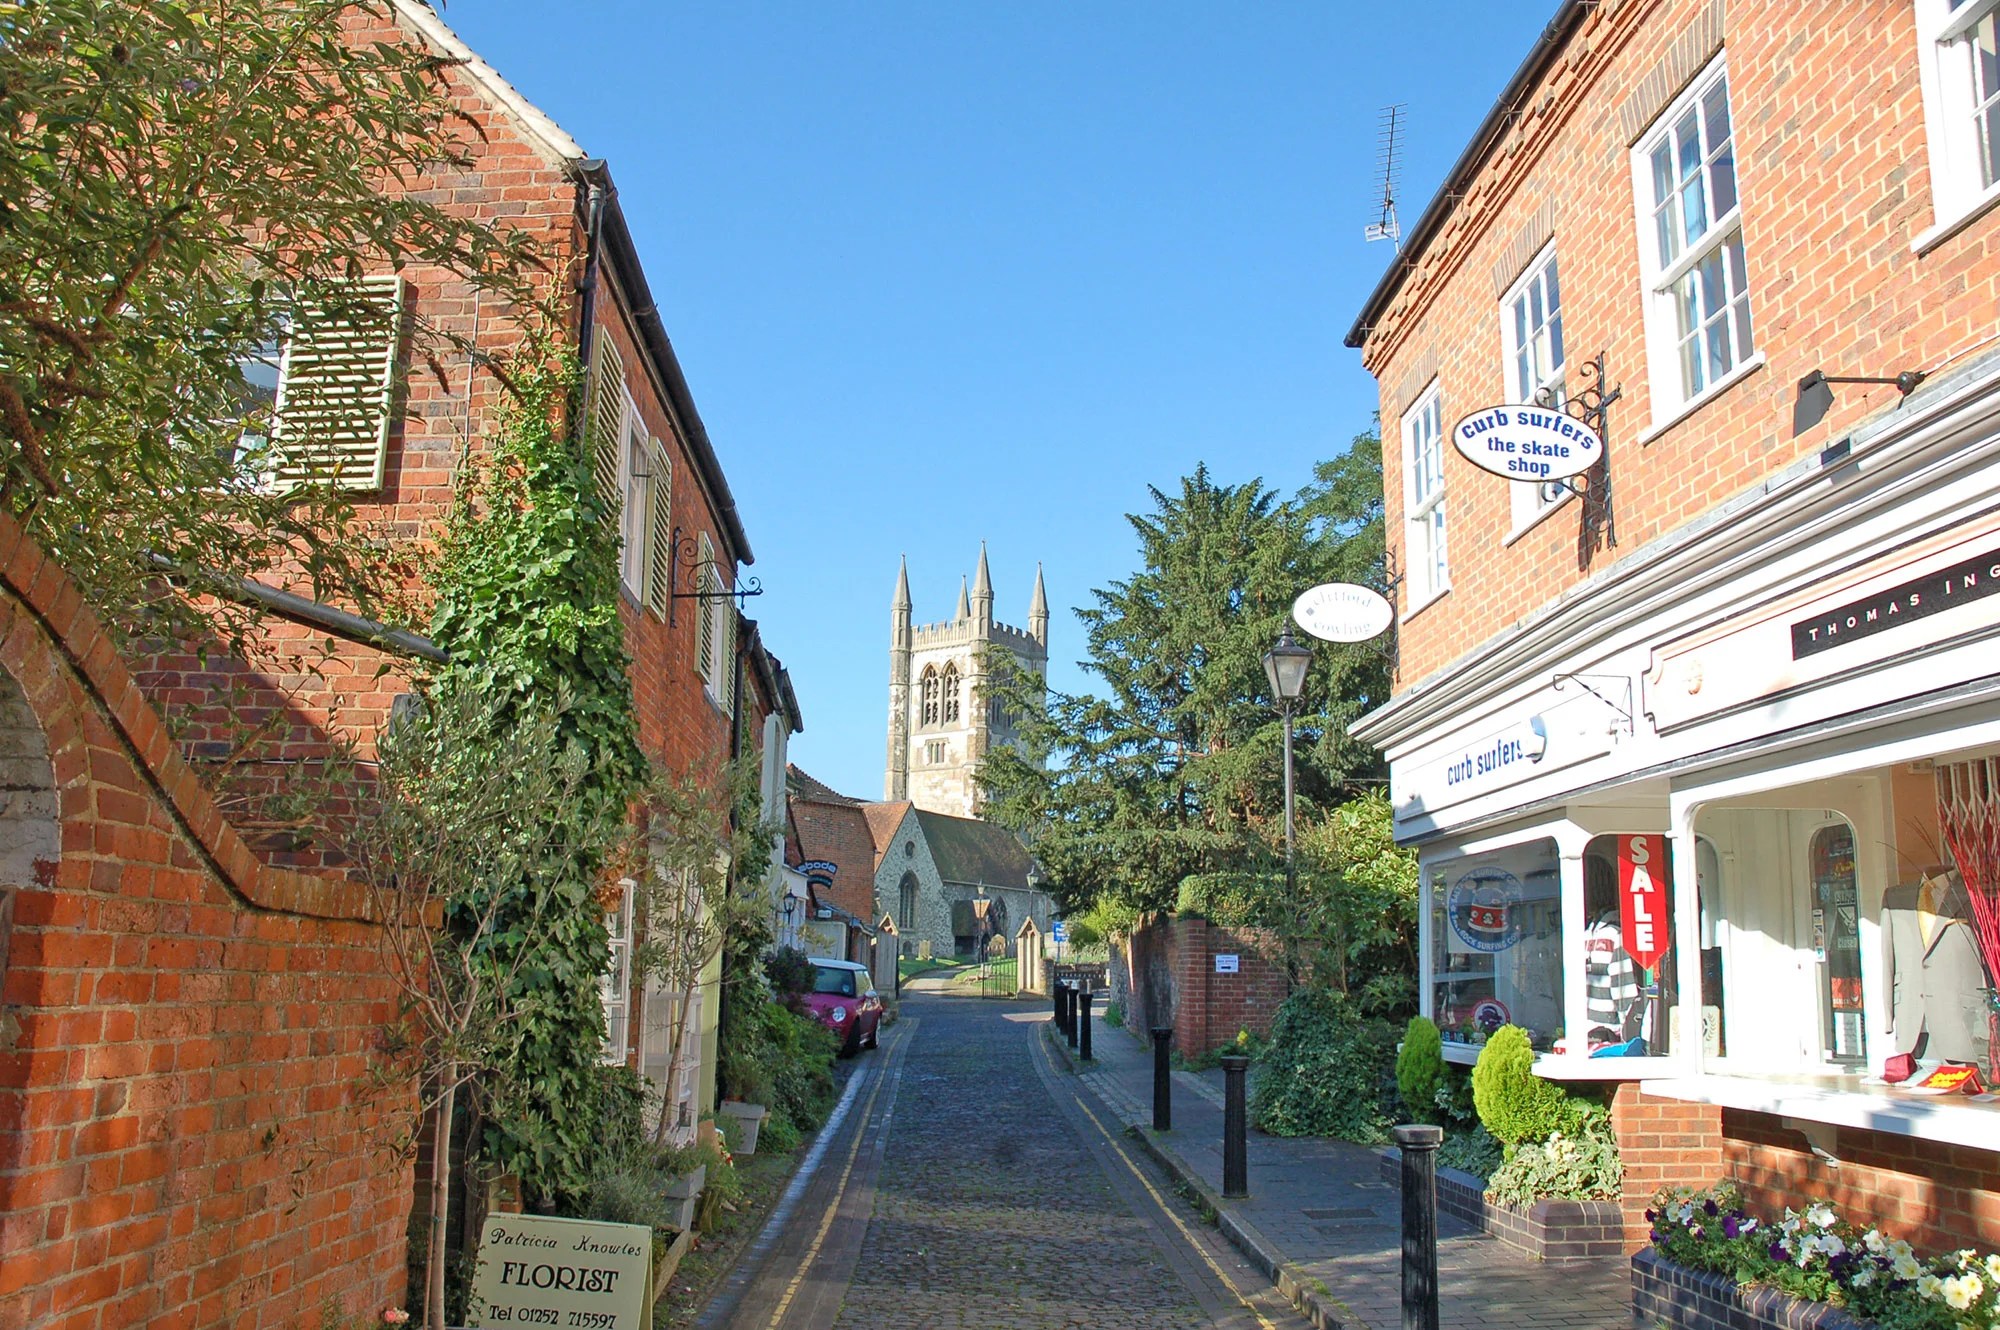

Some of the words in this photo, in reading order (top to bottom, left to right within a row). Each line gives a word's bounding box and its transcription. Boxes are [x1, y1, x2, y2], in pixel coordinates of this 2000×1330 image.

[1461, 409, 1509, 439] curb
[1517, 411, 1594, 450] surfers
[1487, 437, 1515, 453] the
[1522, 440, 1569, 458] skate
[1508, 457, 1550, 477] shop
[1809, 593, 1920, 641] THOMAS
[1447, 754, 1473, 786] curb
[1477, 739, 1524, 776] surfers
[1629, 836, 1655, 952] SALE
[491, 1227, 558, 1249] Patricia
[572, 1235, 642, 1257] Knowles
[500, 1261, 619, 1293] FLORIST
[489, 1305, 512, 1321] Tel
[518, 1308, 559, 1325] 01252
[568, 1311, 617, 1330] 715597
